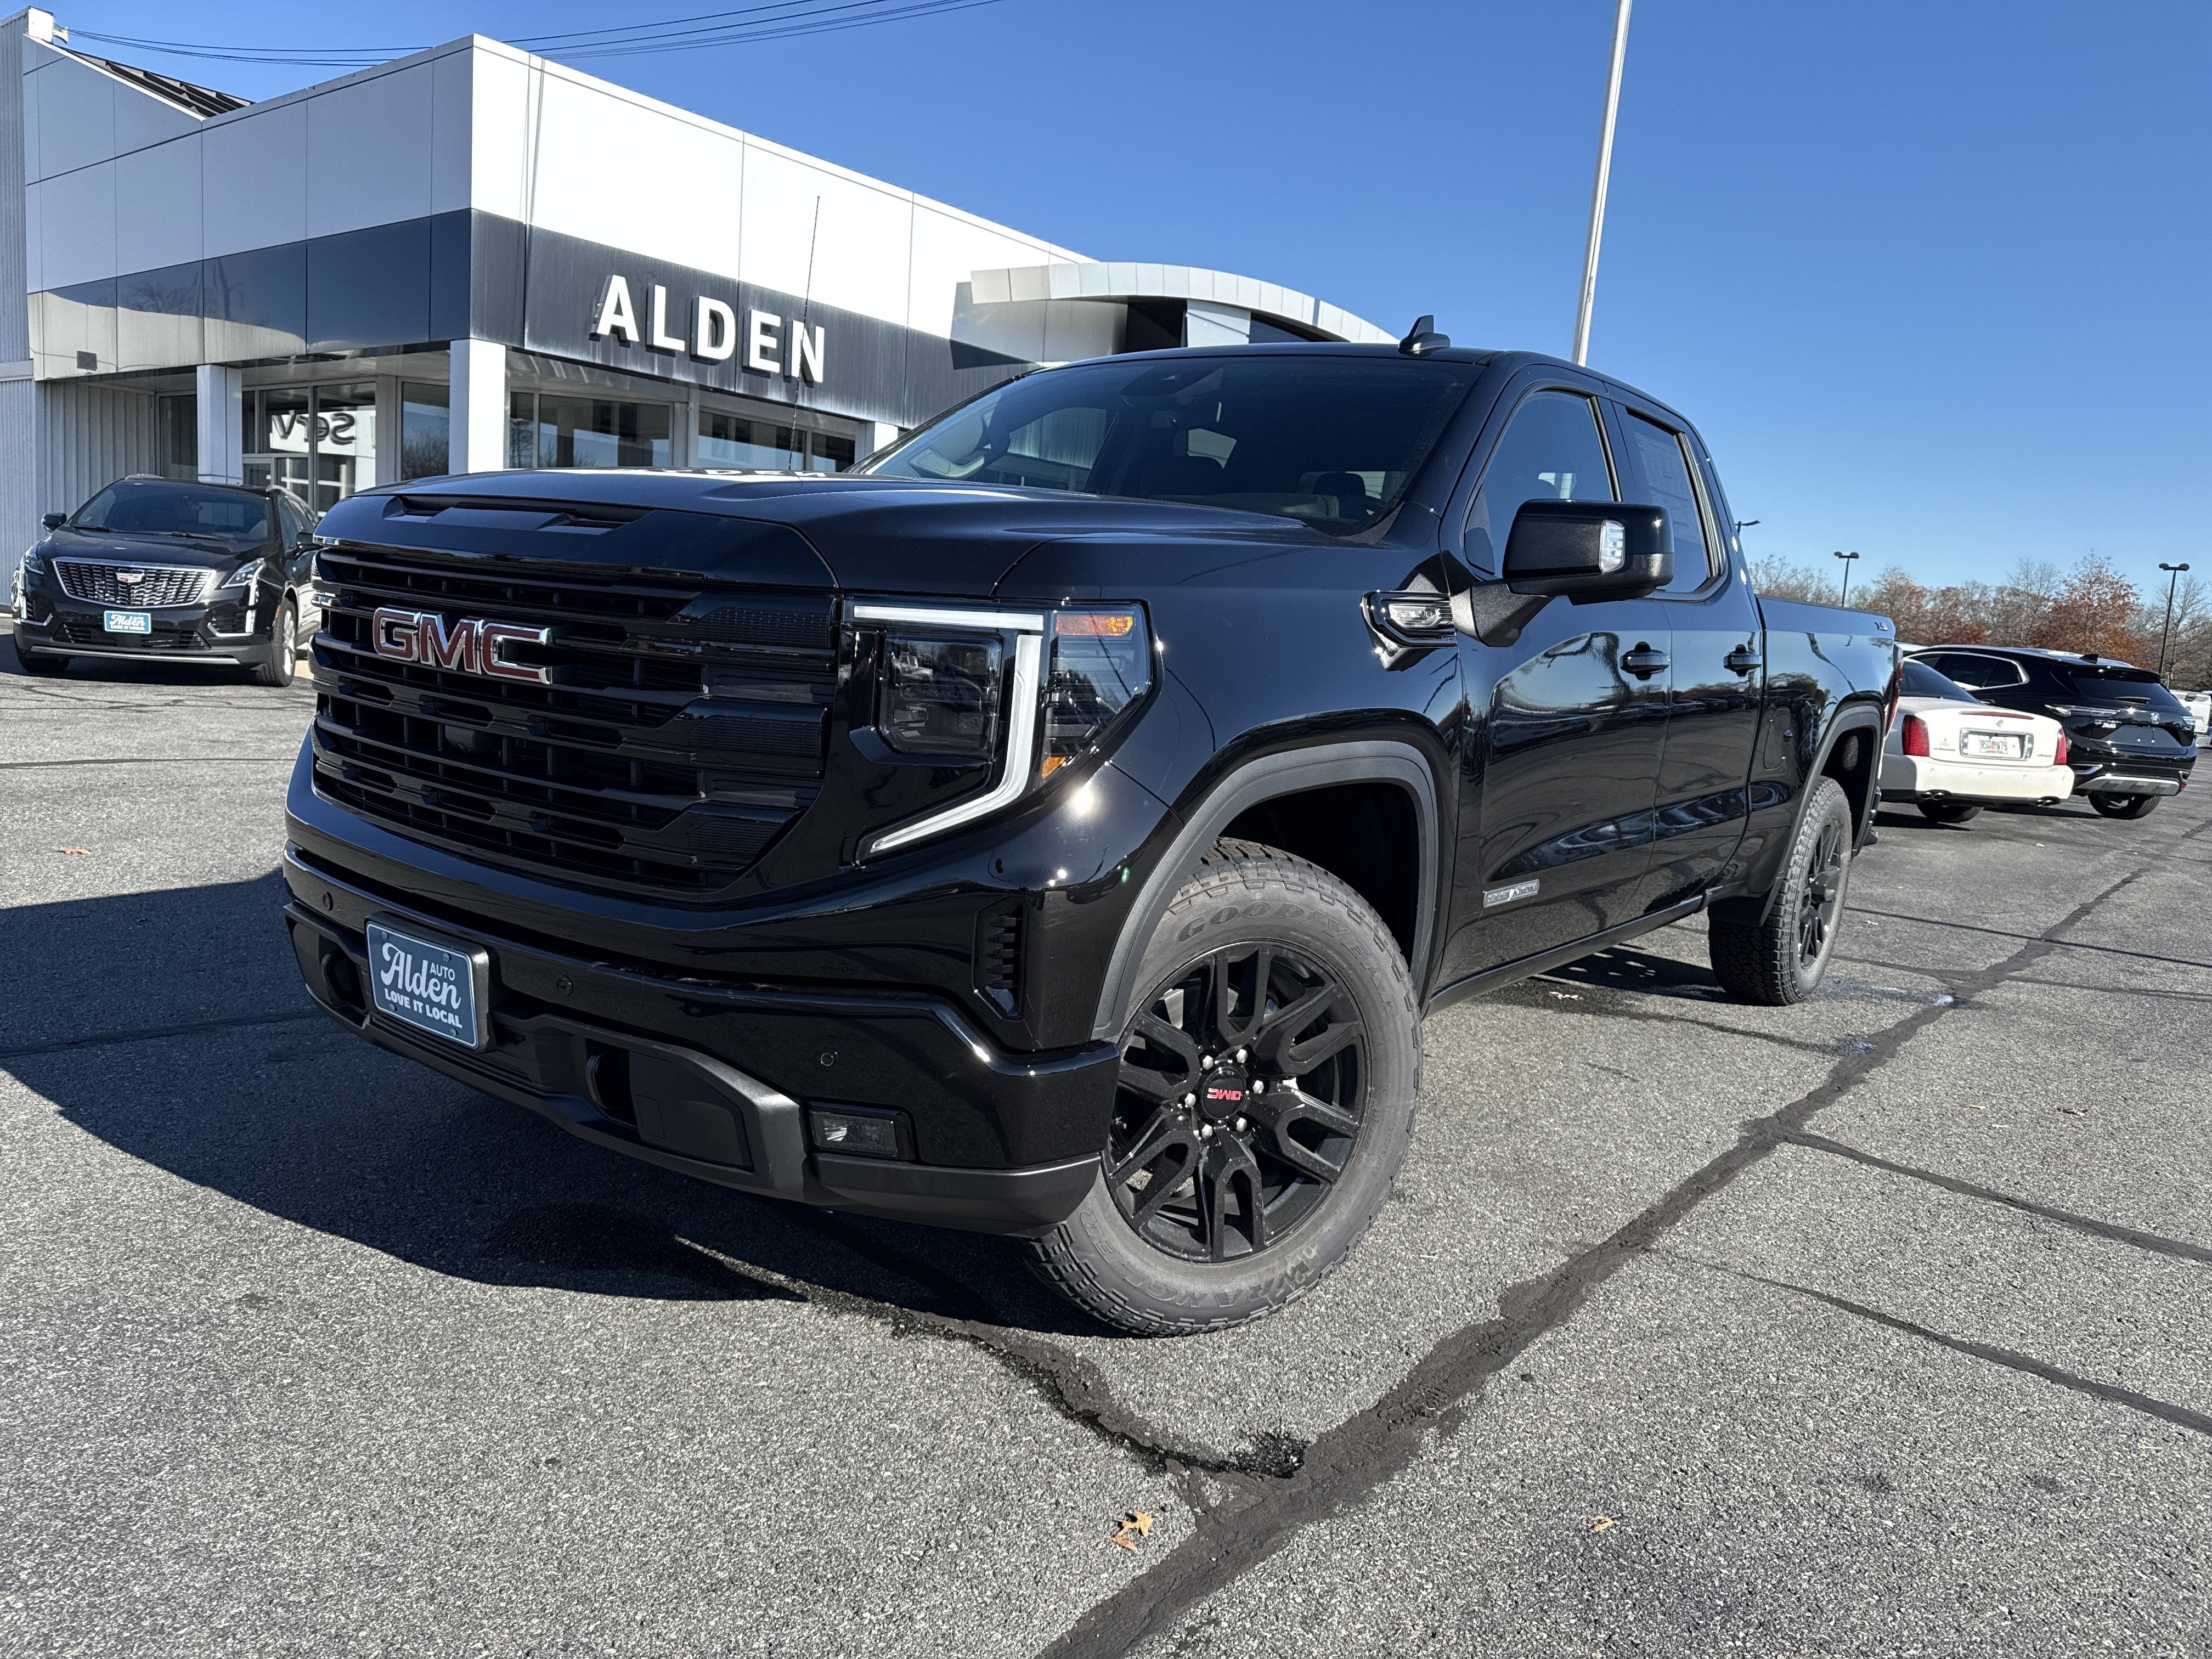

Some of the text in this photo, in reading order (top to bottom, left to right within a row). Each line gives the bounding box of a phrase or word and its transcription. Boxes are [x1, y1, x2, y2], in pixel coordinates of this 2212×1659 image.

[594, 274, 825, 384] ALDEN
[109, 614, 146, 627] Alden
[373, 607, 552, 685] GMC
[380, 942, 461, 1009] Alden
[430, 962, 455, 981] AUTO
[1177, 901, 1400, 1019] GOODYEAR
[384, 988, 463, 1029] LOVE IT LOCAL
[1206, 1087, 1242, 1101] GMC
[1080, 1208, 1316, 1308] WRANGLER
